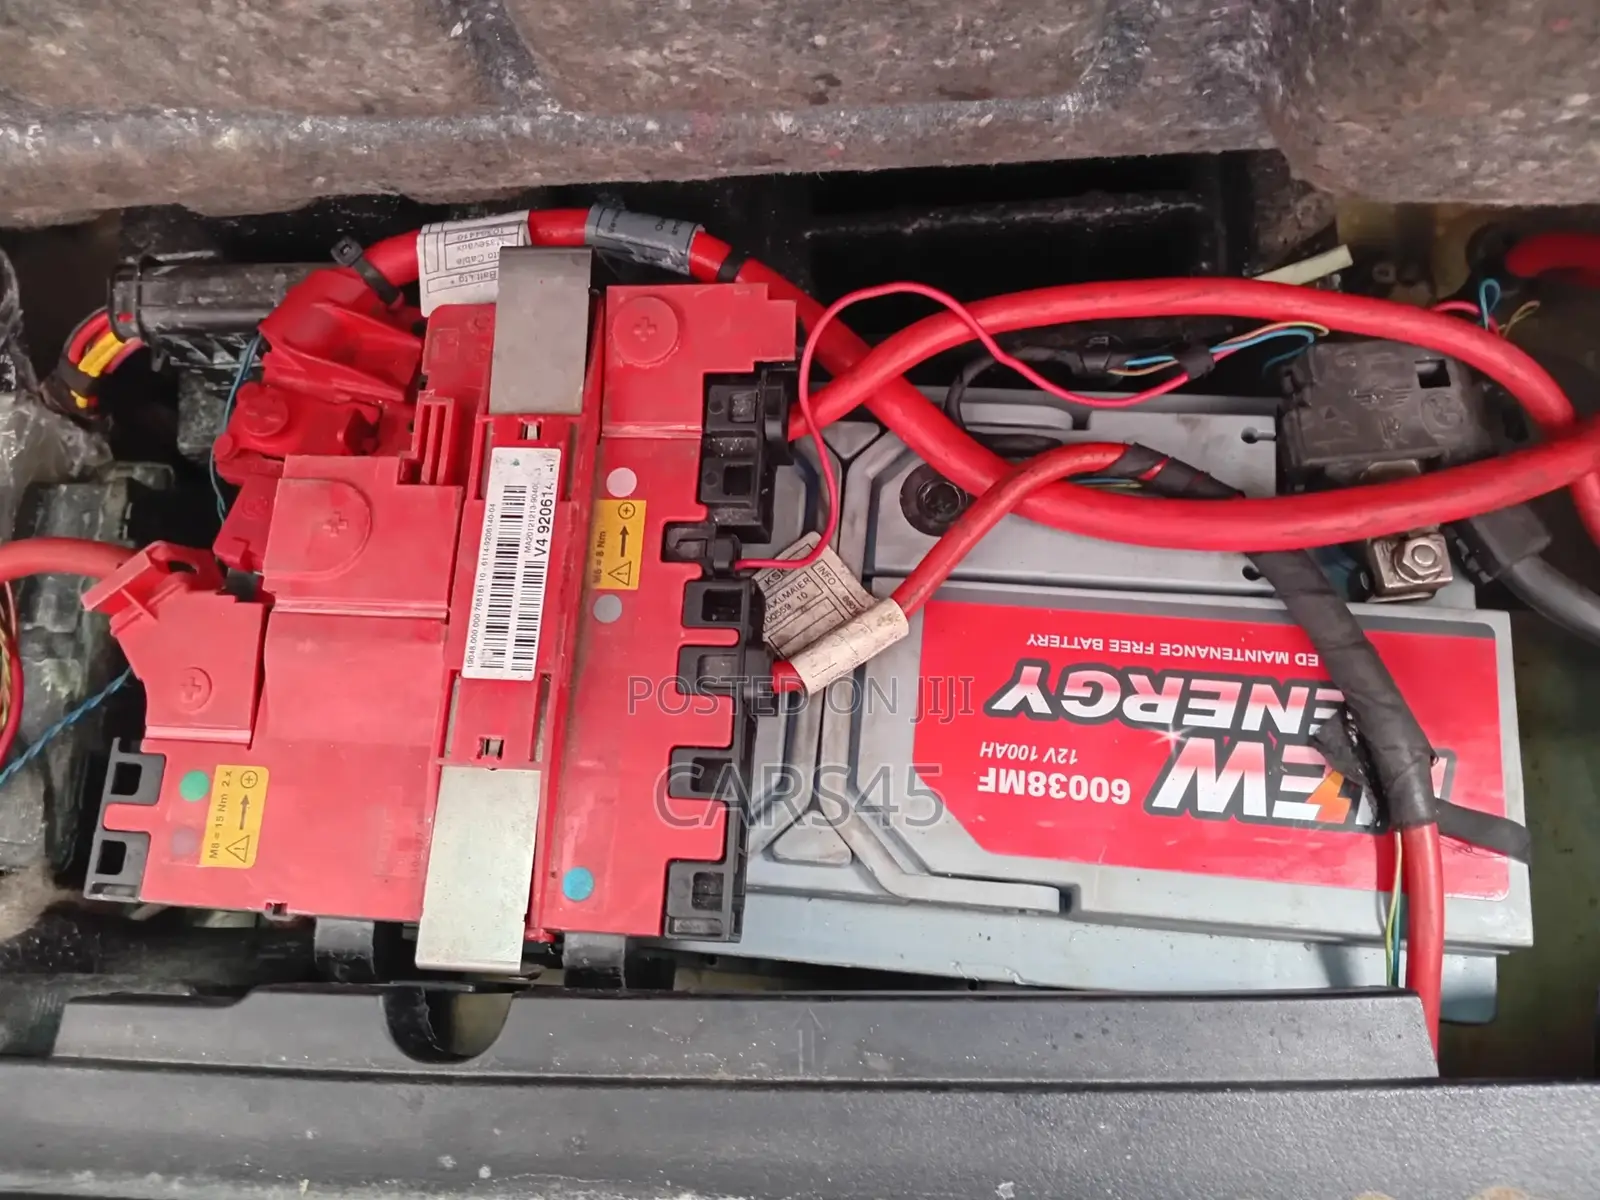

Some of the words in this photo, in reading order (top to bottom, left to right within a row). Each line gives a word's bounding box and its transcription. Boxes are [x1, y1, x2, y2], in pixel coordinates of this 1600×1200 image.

[534, 539, 548, 557] V4
[597, 531, 606, 548] Nm
[817, 565, 837, 586] INFO
[797, 591, 809, 601] 10
[1026, 633, 1104, 651] BATTERY
[1108, 639, 1155, 655] FREE
[1160, 643, 1289, 665] MAINTENANCE
[979, 741, 1038, 761] 100AH
[1042, 748, 1078, 765] 12V
[977, 766, 1131, 805] 60038MF
[218, 793, 228, 812] Nm
[215, 816, 224, 827] 15
[208, 842, 220, 859] M8
